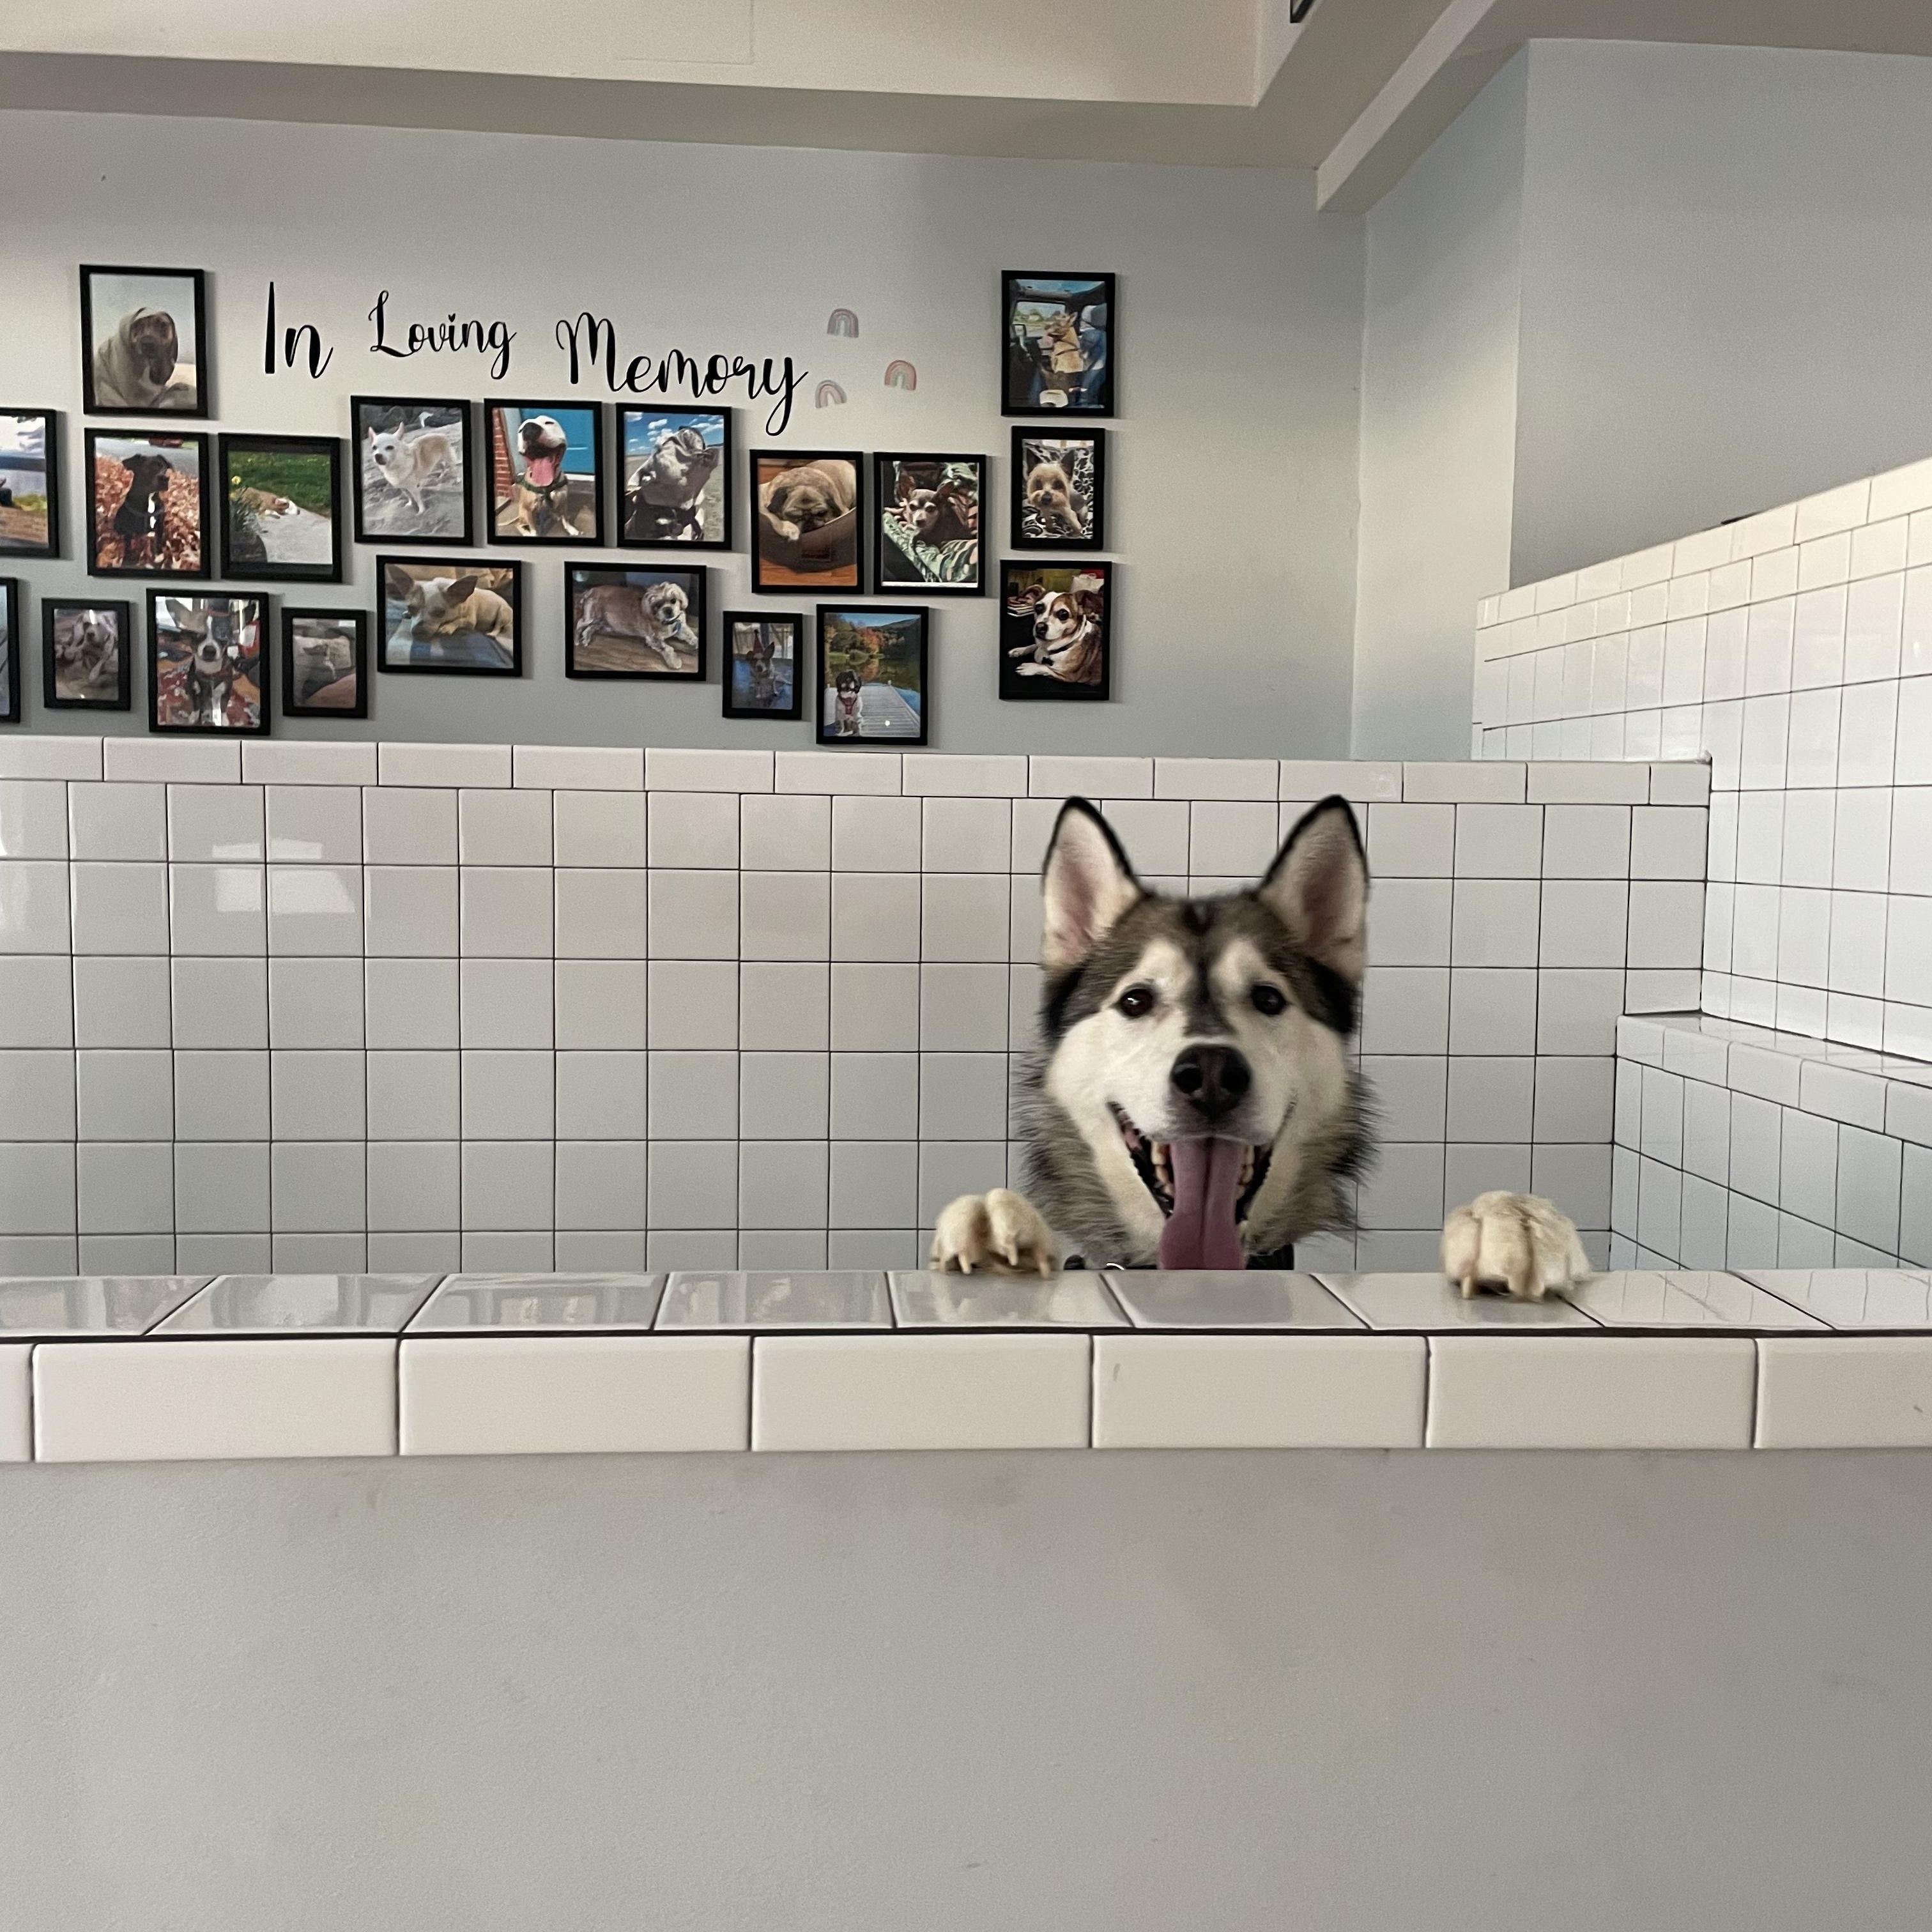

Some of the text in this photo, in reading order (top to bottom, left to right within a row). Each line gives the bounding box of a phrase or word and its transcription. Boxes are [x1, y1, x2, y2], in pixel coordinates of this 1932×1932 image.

[264, 281, 809, 436] In Loving Memory
